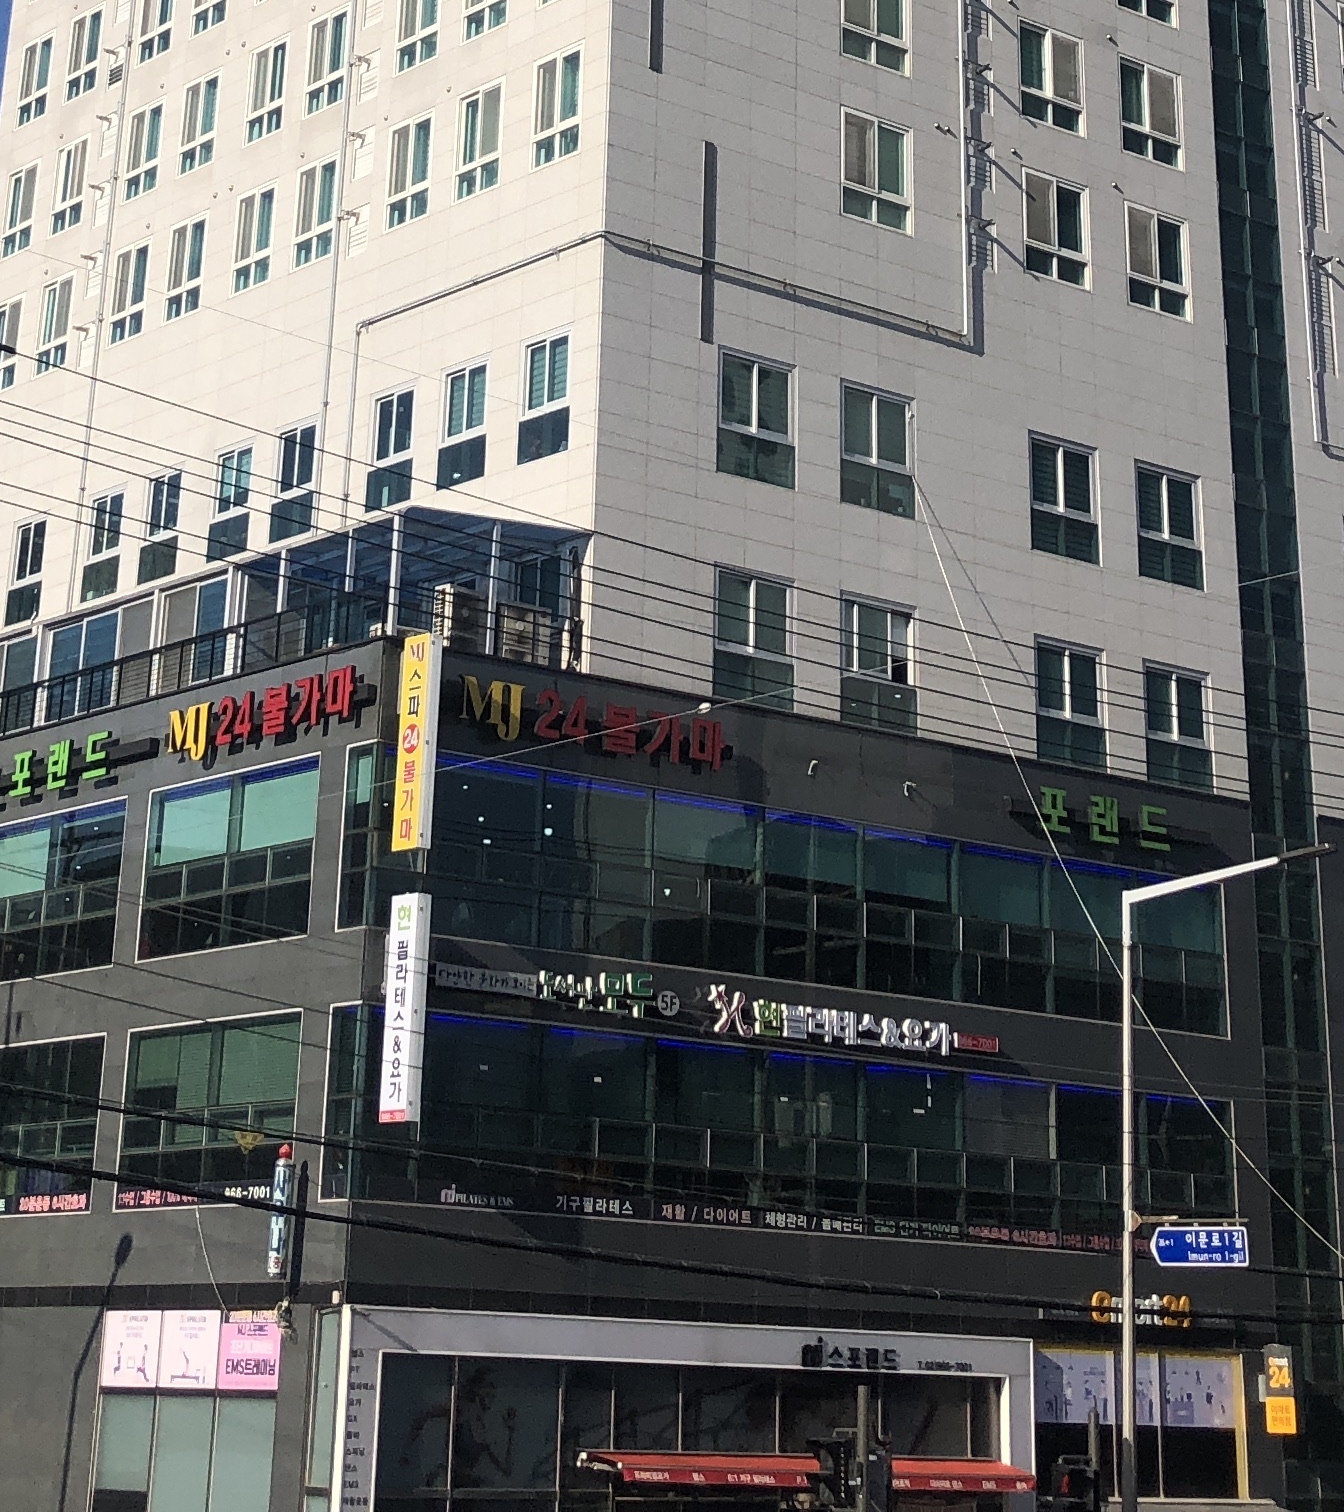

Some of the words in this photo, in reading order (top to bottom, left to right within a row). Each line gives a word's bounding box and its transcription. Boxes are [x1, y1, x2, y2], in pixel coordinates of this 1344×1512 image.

[409, 641, 425, 663] MJ
[407, 668, 422, 717] 스파
[459, 675, 526, 742] MJ
[167, 701, 211, 761] MJ
[402, 727, 418, 749] 24
[398, 759, 417, 842] 불가마
[1037, 785, 1172, 852] 포랜드
[661, 994, 678, 1015] 5F
[556, 1195, 633, 1215] 기구필라테스
[661, 1204, 685, 1221] 재활
[703, 1206, 752, 1224] 다이어트
[765, 1211, 807, 1228] 체형관리
[1269, 1366, 1291, 1388] 24
